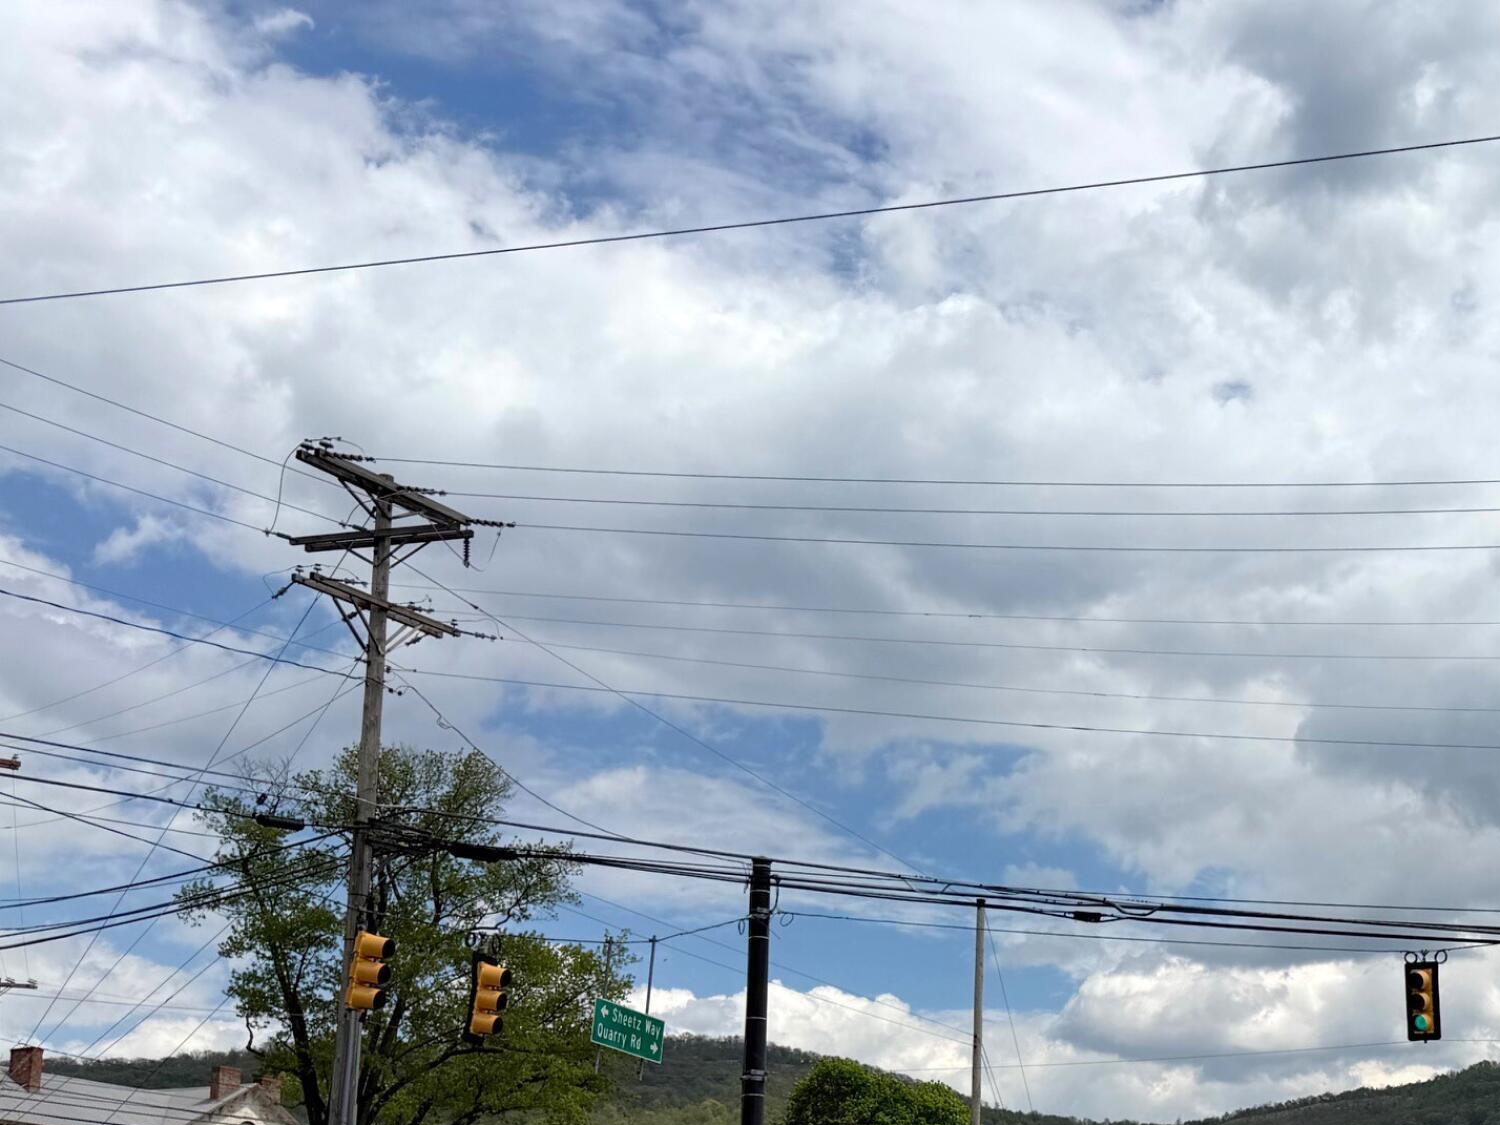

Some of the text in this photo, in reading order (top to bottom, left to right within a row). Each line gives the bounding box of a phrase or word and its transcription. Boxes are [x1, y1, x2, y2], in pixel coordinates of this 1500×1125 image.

[597, 1022, 642, 1050] Quarry Rd
[611, 1007, 661, 1041] Sheetz Way
